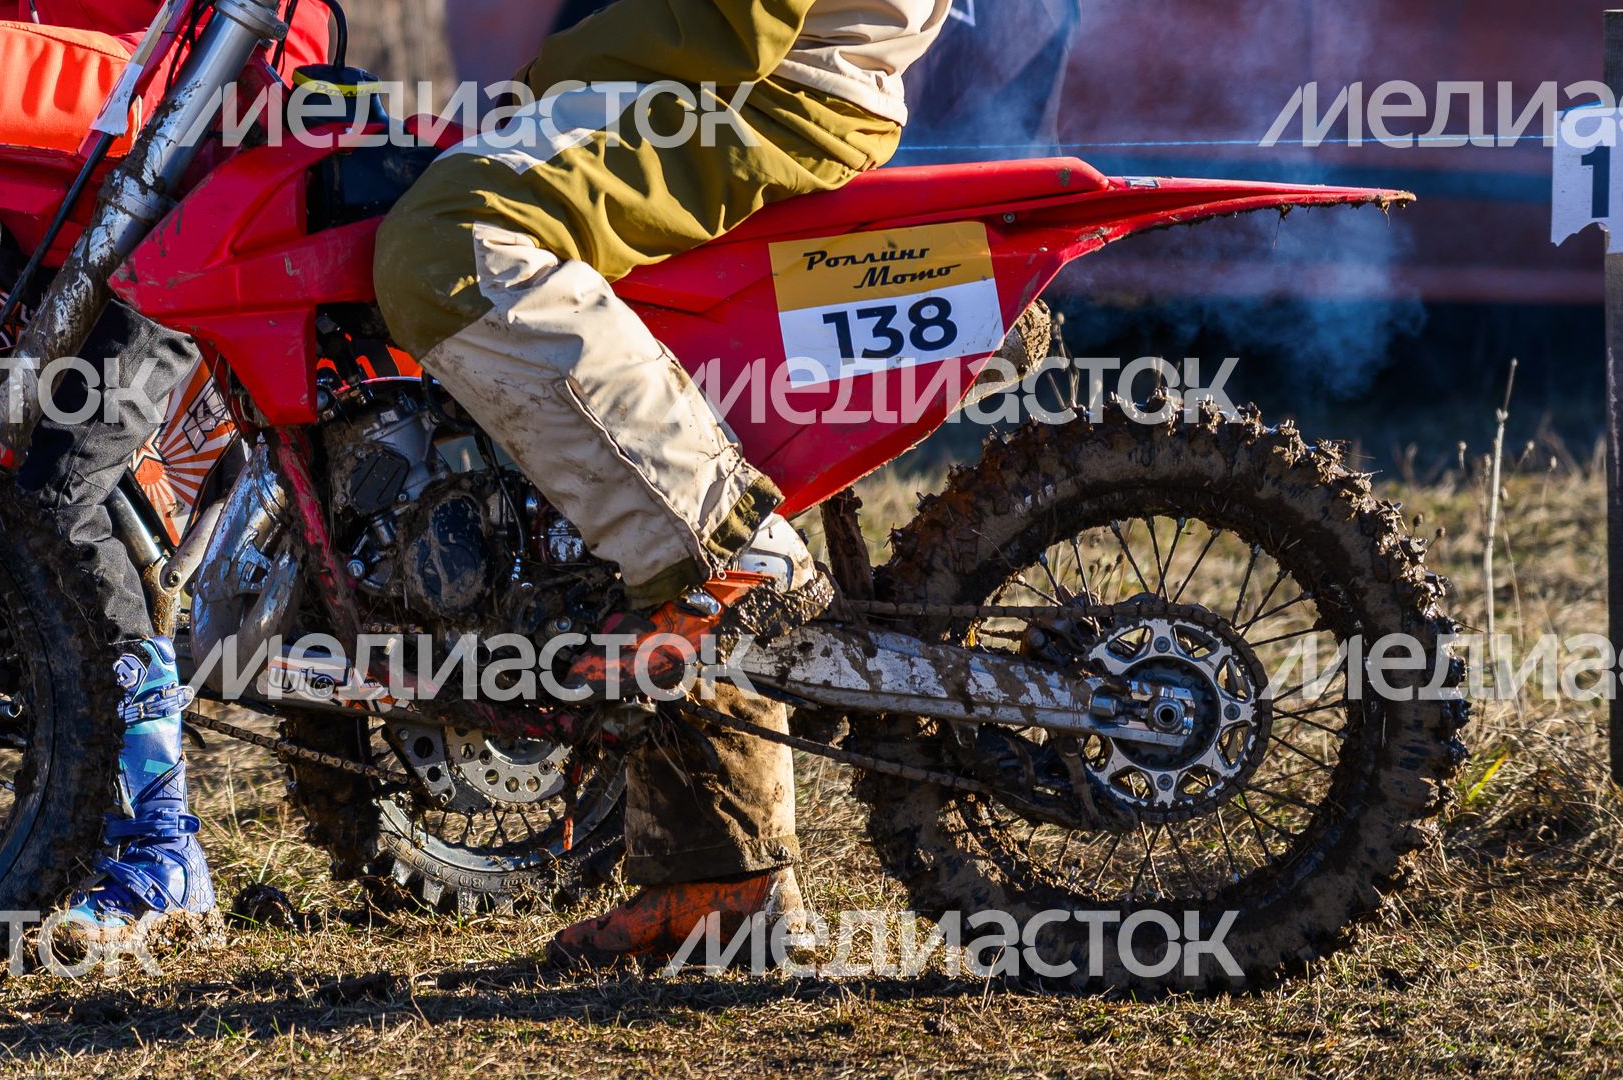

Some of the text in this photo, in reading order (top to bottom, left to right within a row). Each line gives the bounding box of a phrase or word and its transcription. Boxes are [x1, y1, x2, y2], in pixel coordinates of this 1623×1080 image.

[803, 247, 931, 271] Роллинг
[852, 263, 962, 289] Мото
[823, 296, 958, 366] 138
